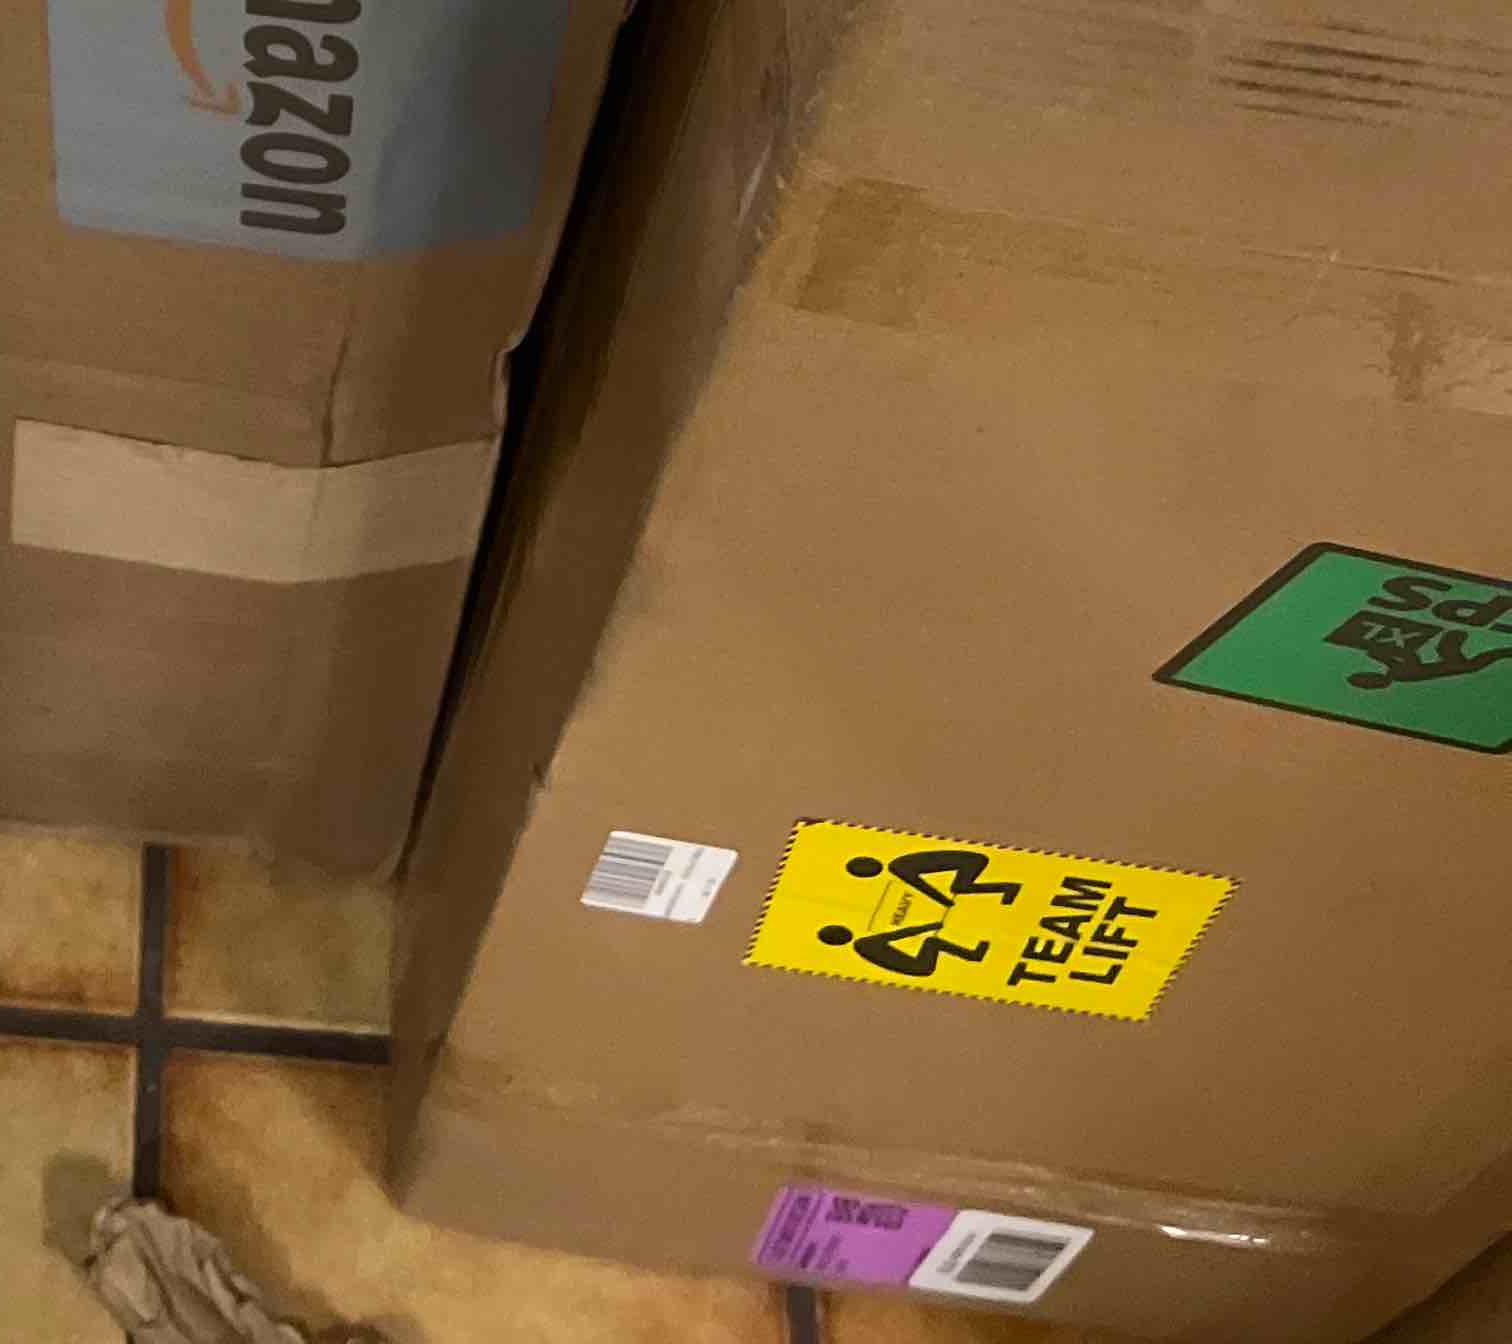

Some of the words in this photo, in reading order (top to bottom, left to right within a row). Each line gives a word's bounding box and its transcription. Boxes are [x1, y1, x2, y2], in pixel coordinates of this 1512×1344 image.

[1360, 619, 1423, 650] XL
[1367, 576, 1512, 633] PS
[1007, 875, 1113, 987] TEAM
[1069, 896, 1158, 986] LIFT
